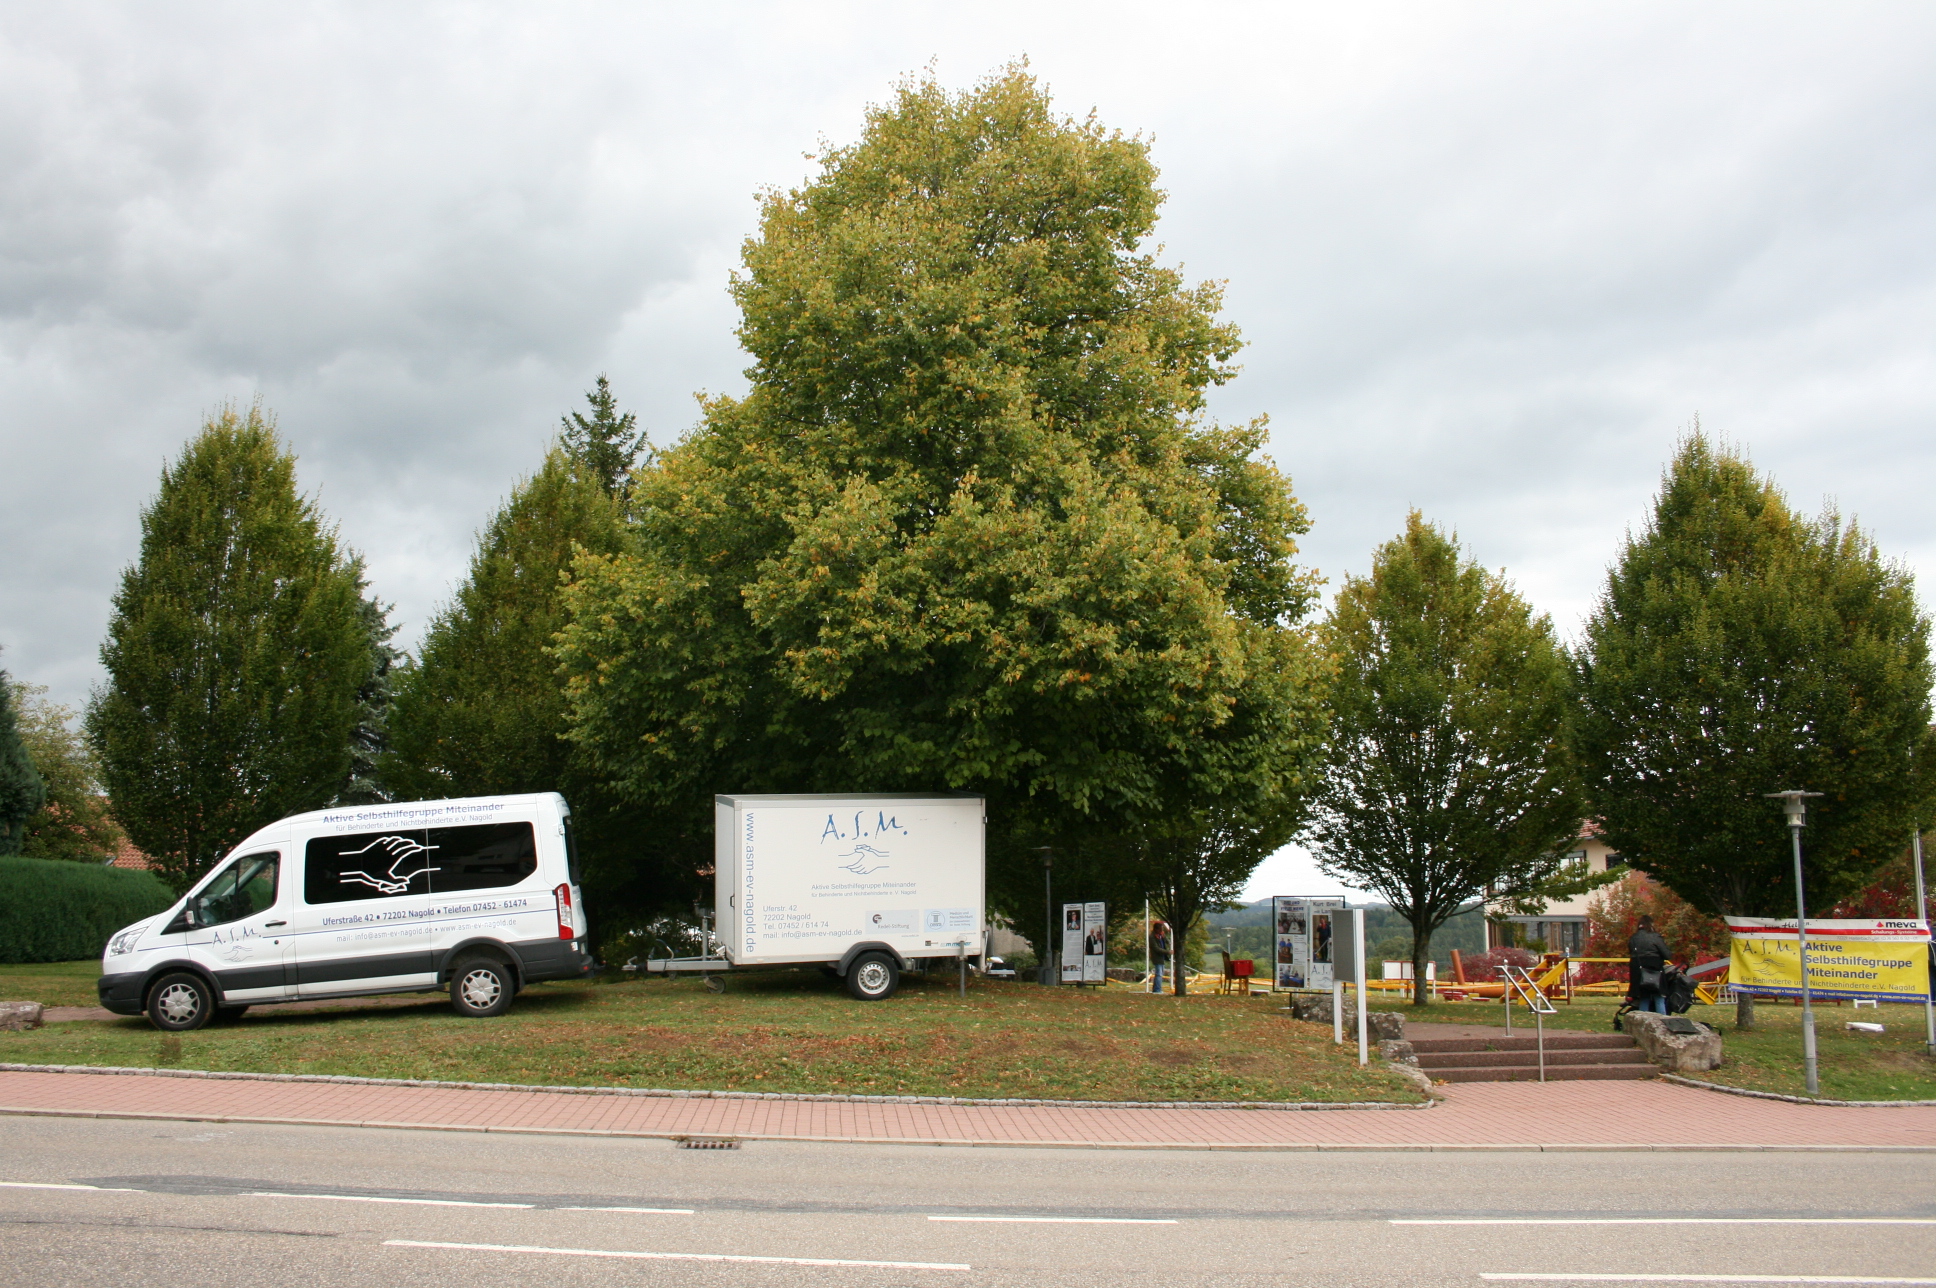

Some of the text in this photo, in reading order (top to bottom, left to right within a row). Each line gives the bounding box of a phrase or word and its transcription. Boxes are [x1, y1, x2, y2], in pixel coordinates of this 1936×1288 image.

[323, 803, 504, 824] Aktive Selbsthilfegruppe Miteinander
[347, 821, 384, 831] Behinderte
[401, 816, 453, 826] Nichtbehinderte
[469, 814, 493, 822] Nagold
[744, 812, 757, 953] www.asm-ev-nagold.de
[831, 882, 881, 891] Selbsthilfegruppe
[322, 914, 362, 926] Uferstraße
[364, 914, 374, 922] 42
[383, 911, 407, 920] 72202
[408, 907, 434, 919] Nagold
[443, 904, 471, 915] Telefon
[472, 902, 497, 912] 07452
[504, 899, 527, 909] 61474
[786, 913, 811, 921] Nagold
[336, 918, 516, 942] mail: info@asm-ev-nagold.de www.asm-ev-nagold.de
[778, 922, 800, 930] 07452
[781, 929, 862, 940] info@asm-ev-nagold.de
[1805, 942, 1843, 952] Aktive
[1805, 955, 1912, 969] Selbsthilfegruppe
[1806, 968, 1878, 979] Miteinander
[1753, 977, 1792, 985] Behinderte
[1810, 980, 1869, 990] Nichtbehinderte
[1889, 983, 1916, 991] Nagold
